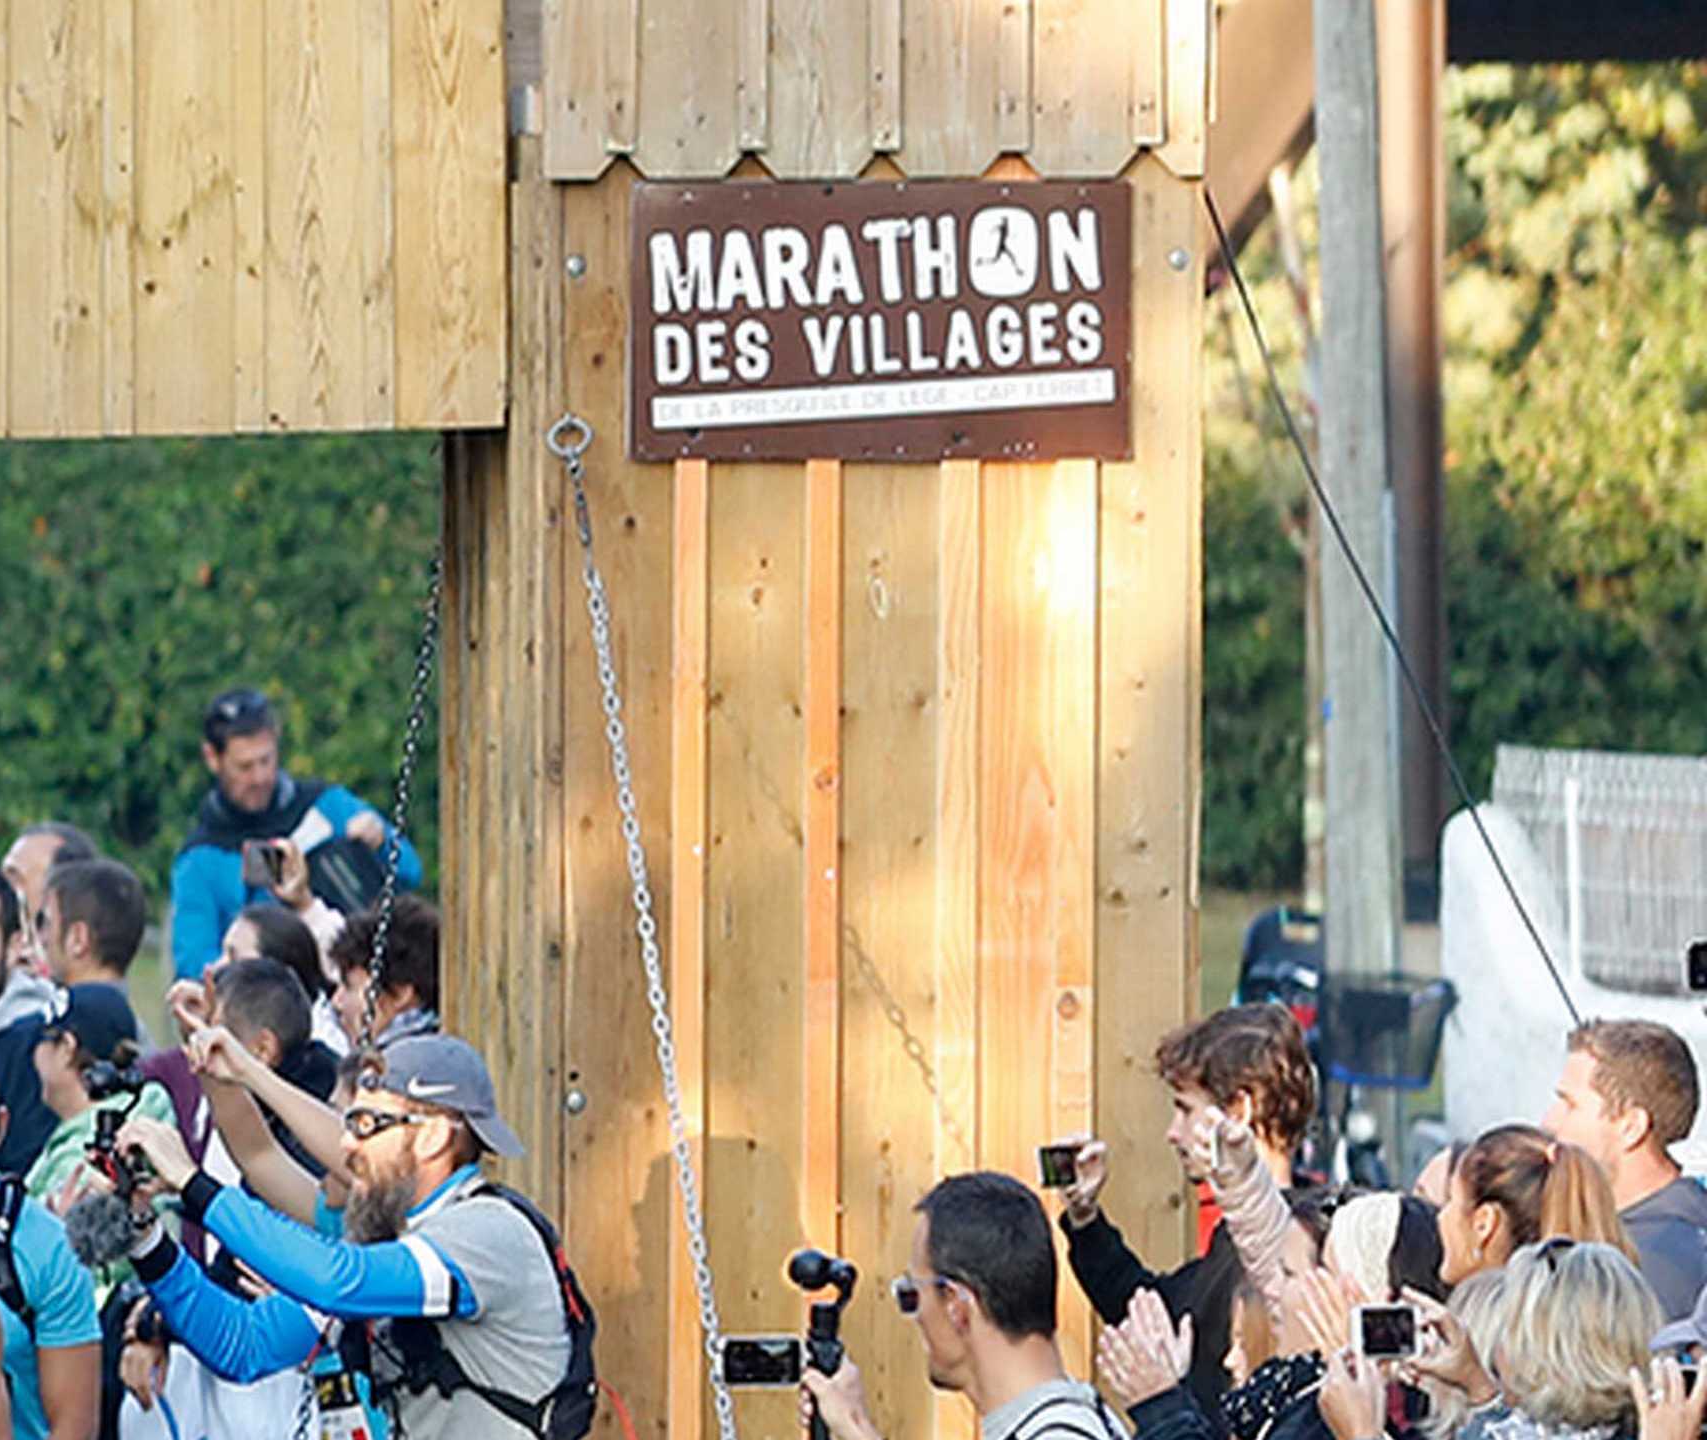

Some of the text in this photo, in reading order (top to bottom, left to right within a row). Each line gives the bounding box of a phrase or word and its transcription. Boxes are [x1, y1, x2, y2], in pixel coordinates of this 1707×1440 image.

[648, 206, 1102, 314] MARATHON
[653, 301, 1102, 386] DES VILLAGES
[973, 382, 1017, 402] CAP
